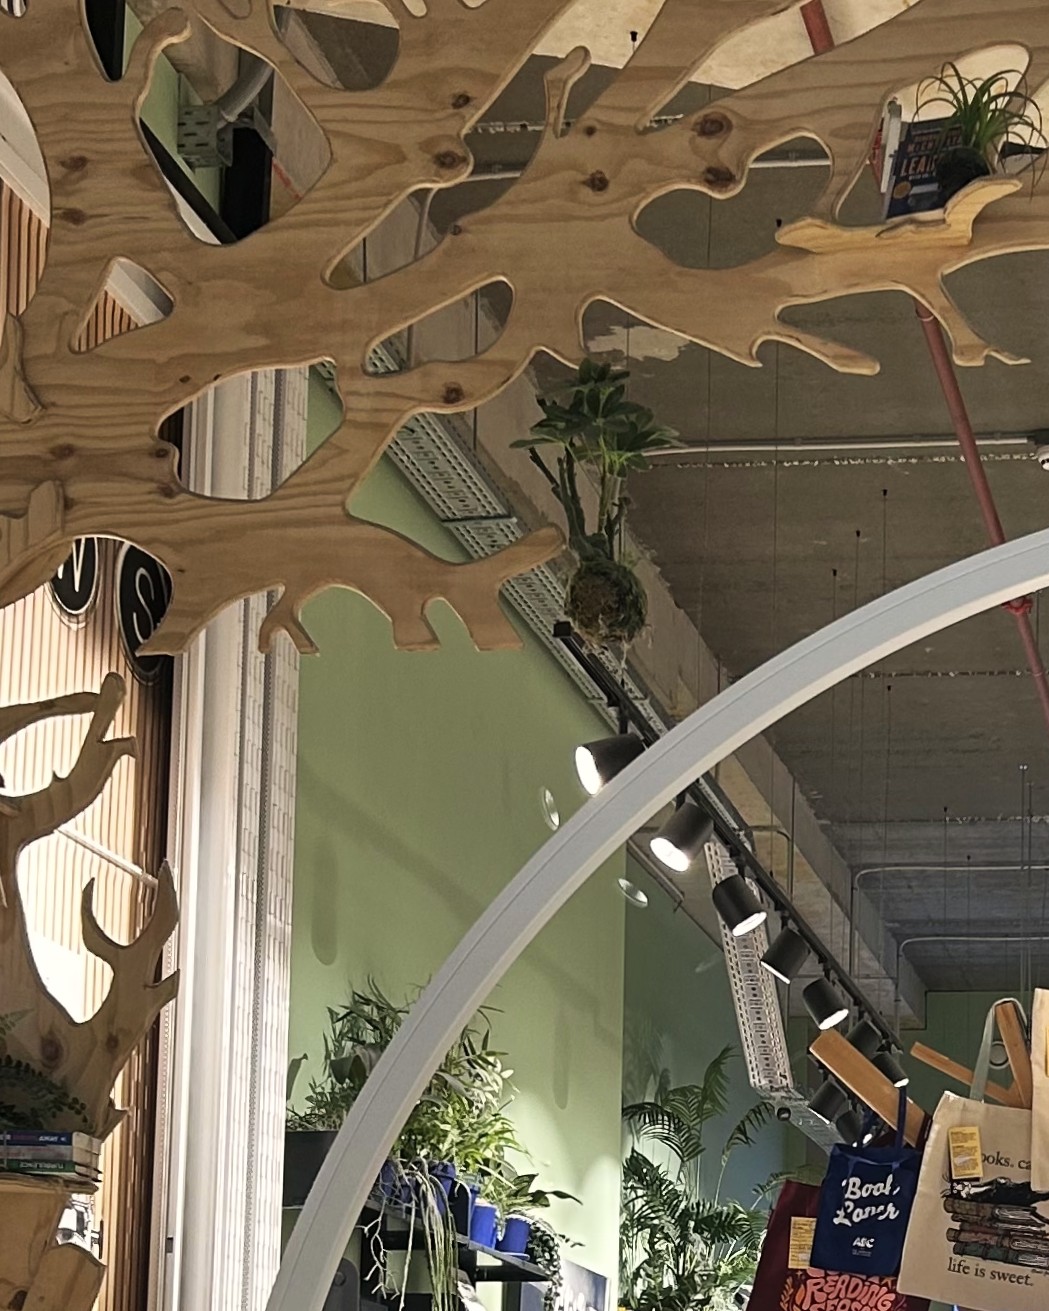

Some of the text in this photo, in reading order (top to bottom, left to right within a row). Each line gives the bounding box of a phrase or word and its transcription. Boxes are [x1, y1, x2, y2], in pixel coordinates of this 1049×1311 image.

[947, 1257, 971, 1275] life
[974, 1263, 986, 1278] is
[990, 1269, 1035, 1287] sweet.
[802, 1277, 896, 1311] READING
